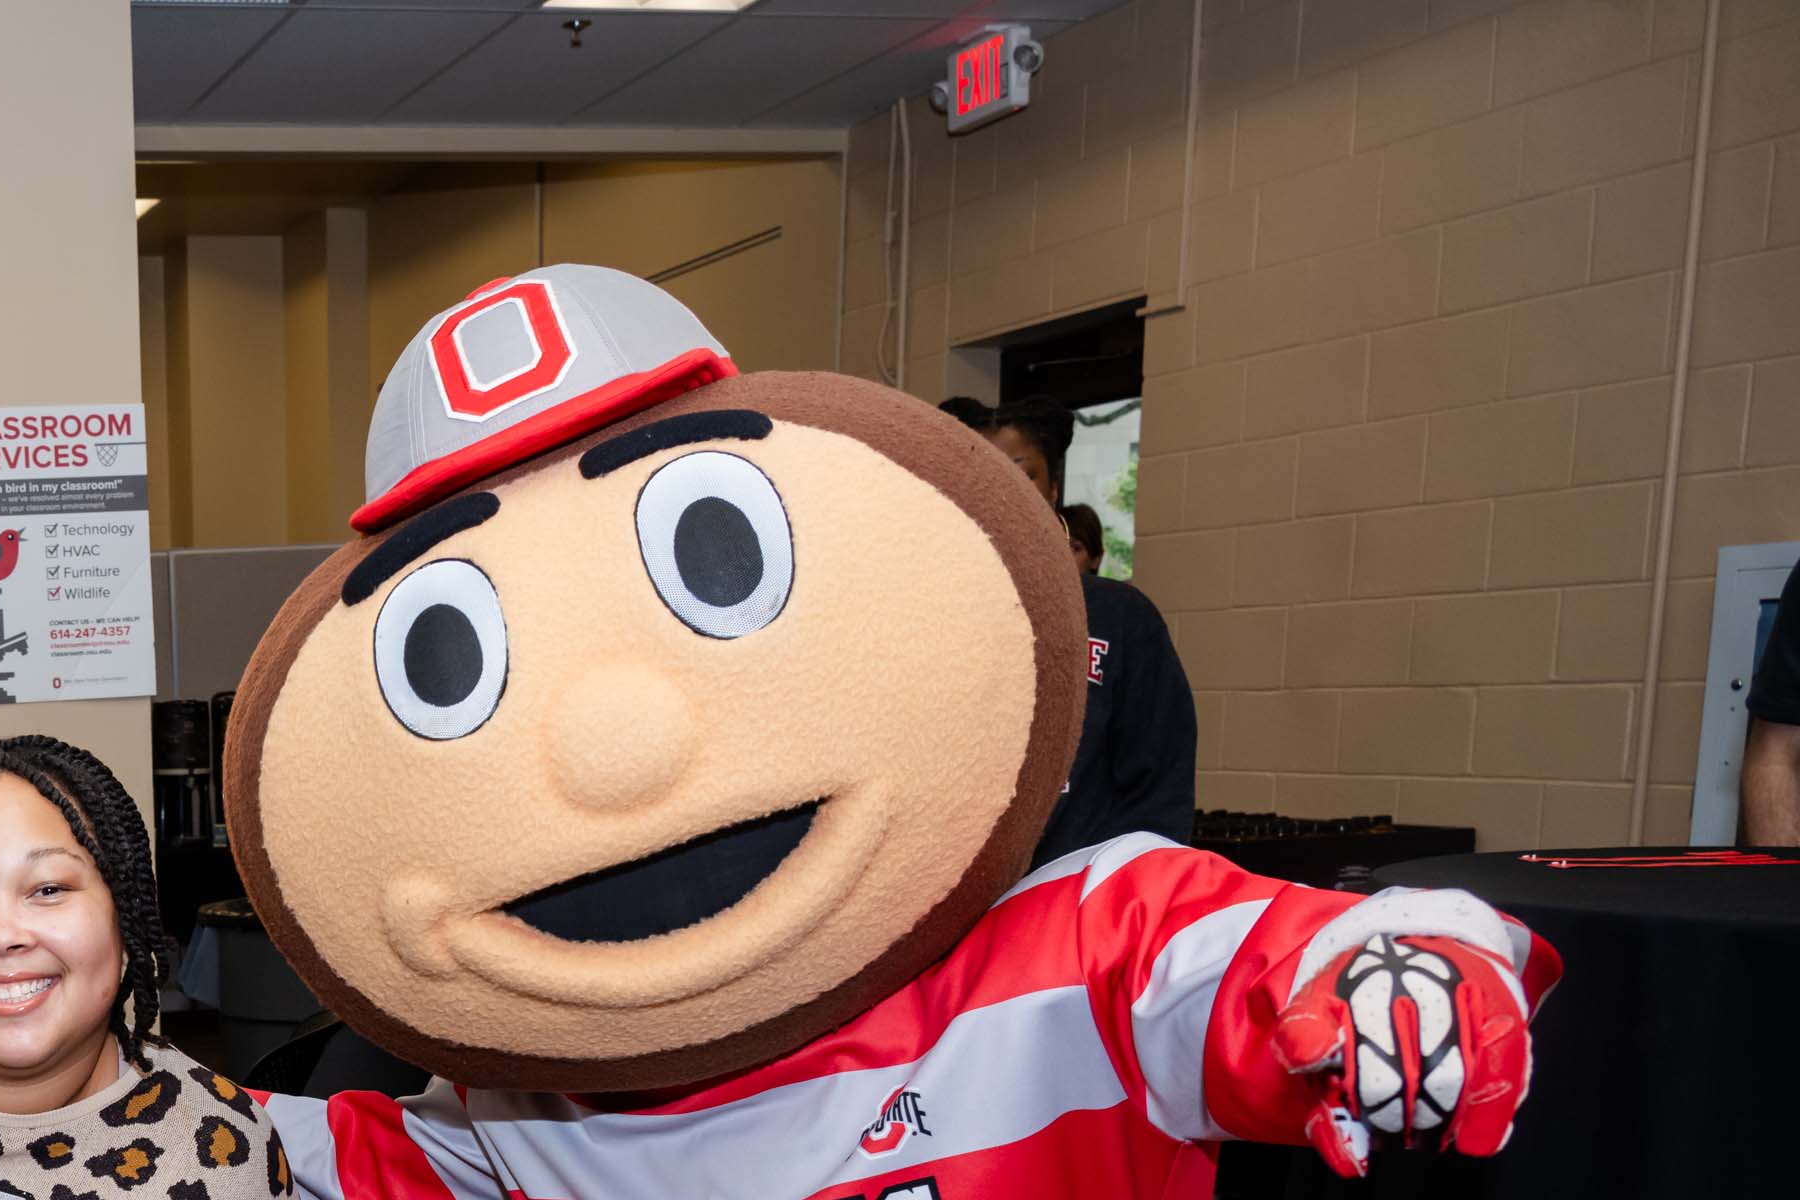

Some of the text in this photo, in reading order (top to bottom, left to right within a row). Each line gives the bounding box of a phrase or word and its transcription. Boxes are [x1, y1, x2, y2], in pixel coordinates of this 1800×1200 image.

[957, 33, 1004, 116] EXIT
[426, 279, 578, 422] O
[5, 483, 27, 494] bird
[29, 482, 40, 492] in
[42, 484, 58, 494] my
[62, 523, 135, 536] Technology
[63, 544, 101, 557] HVAC
[63, 566, 120, 578] Furniture
[64, 586, 111, 600] Wildlife
[50, 625, 130, 640] 614-247-4357
